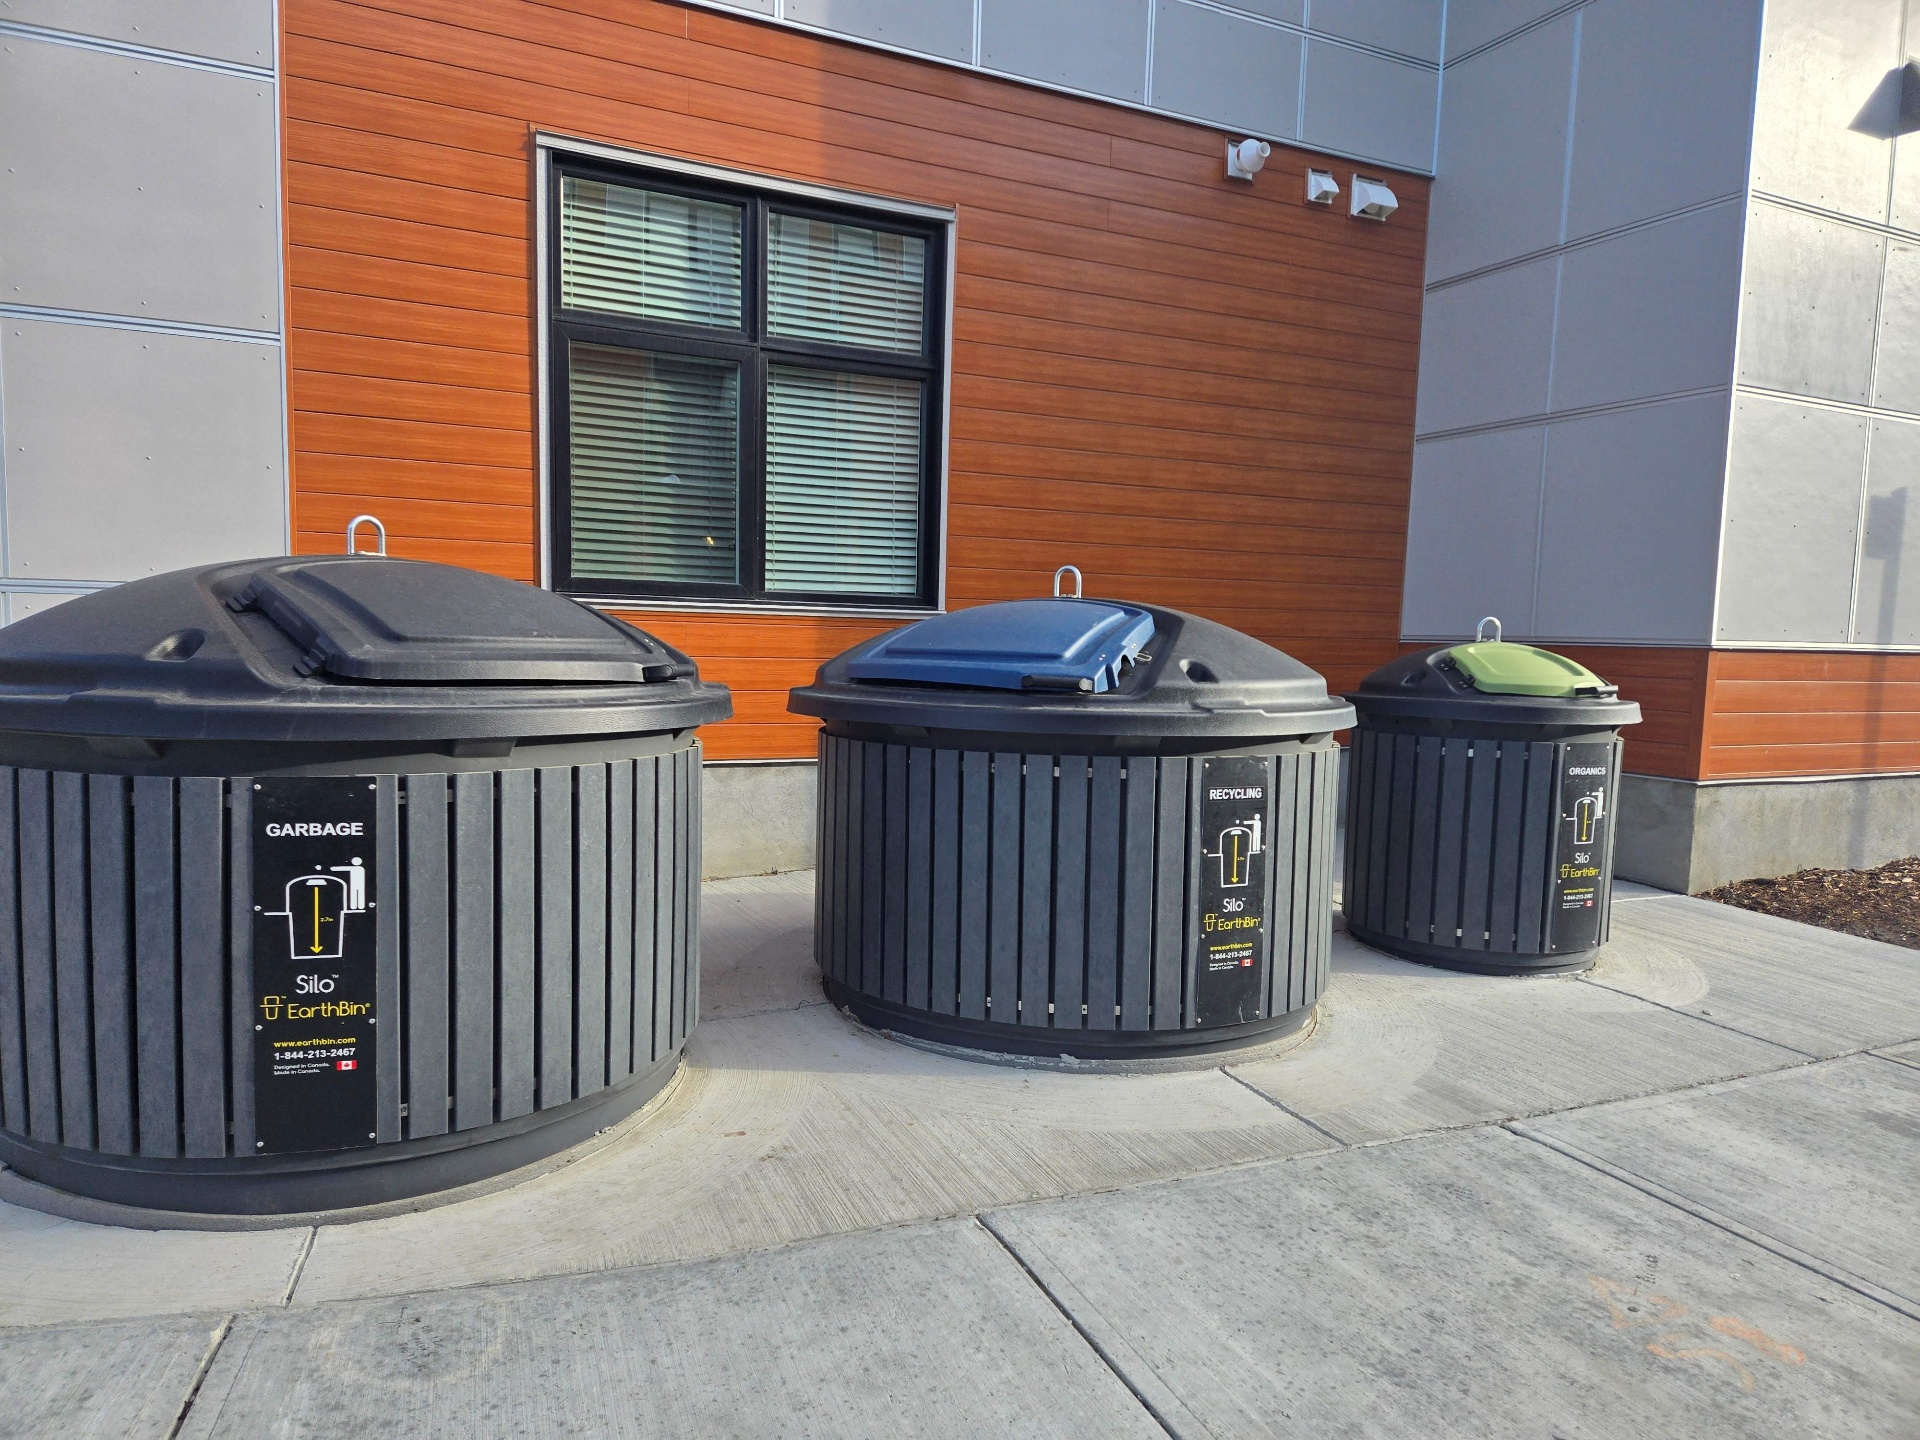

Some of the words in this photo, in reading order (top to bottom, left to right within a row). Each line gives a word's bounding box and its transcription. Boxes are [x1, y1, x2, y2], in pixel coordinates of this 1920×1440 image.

[1569, 767, 1607, 776] ORGANICS
[1209, 788, 1263, 800] RECYCLING
[266, 822, 364, 837] GARBAGE
[273, 1037, 357, 1048] www.earthbin.com
[273, 1047, 357, 1061] 1-844-213-2467
[273, 1063, 300, 1071] Designed
